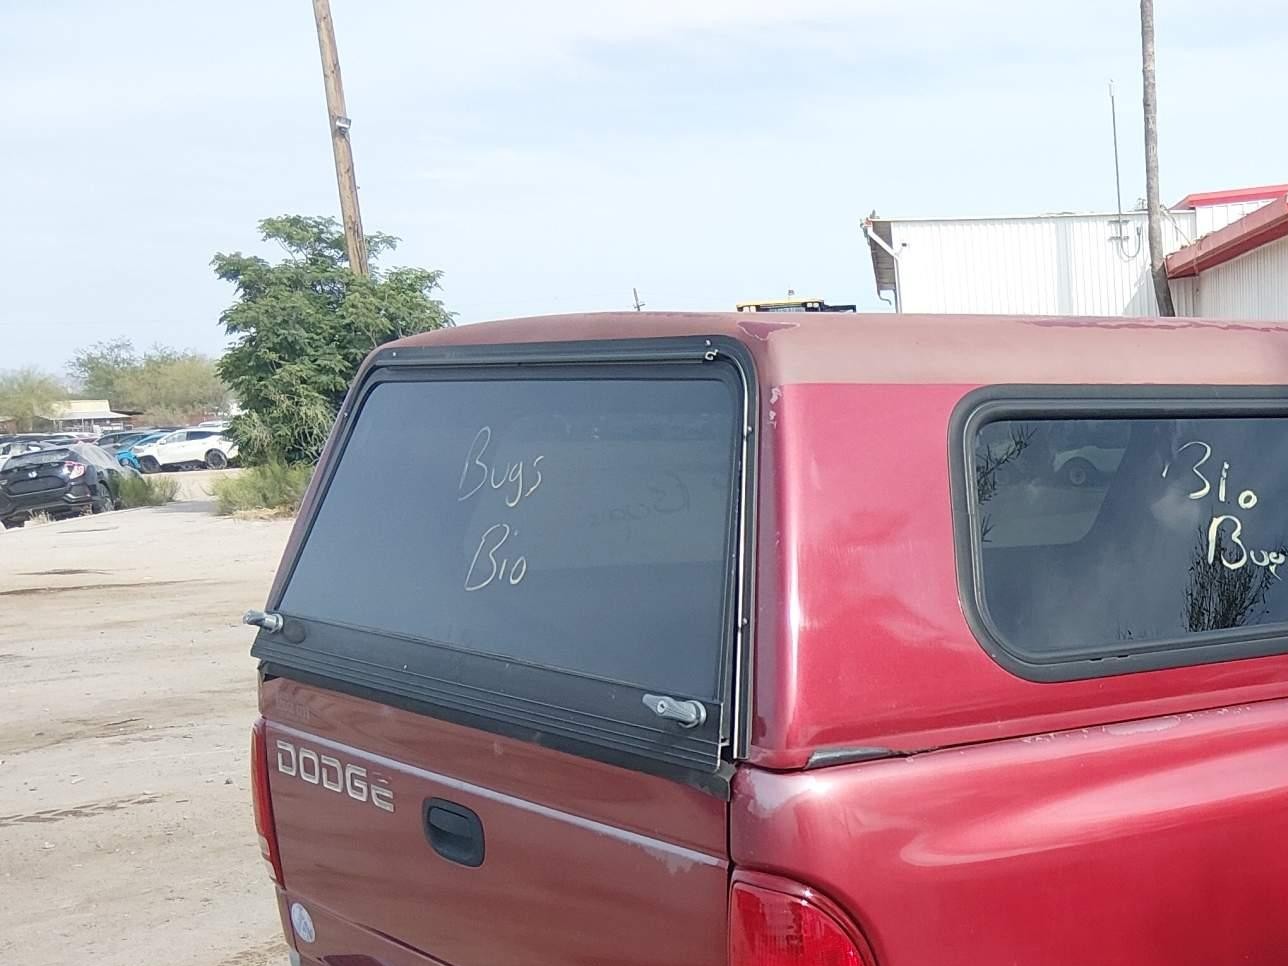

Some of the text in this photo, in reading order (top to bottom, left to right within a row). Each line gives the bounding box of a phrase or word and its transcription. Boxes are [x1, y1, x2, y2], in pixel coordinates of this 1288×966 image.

[457, 425, 545, 508] Bugs
[1161, 440, 1259, 510] Bio
[463, 522, 527, 592] Bio
[276, 739, 395, 813] DODGE
